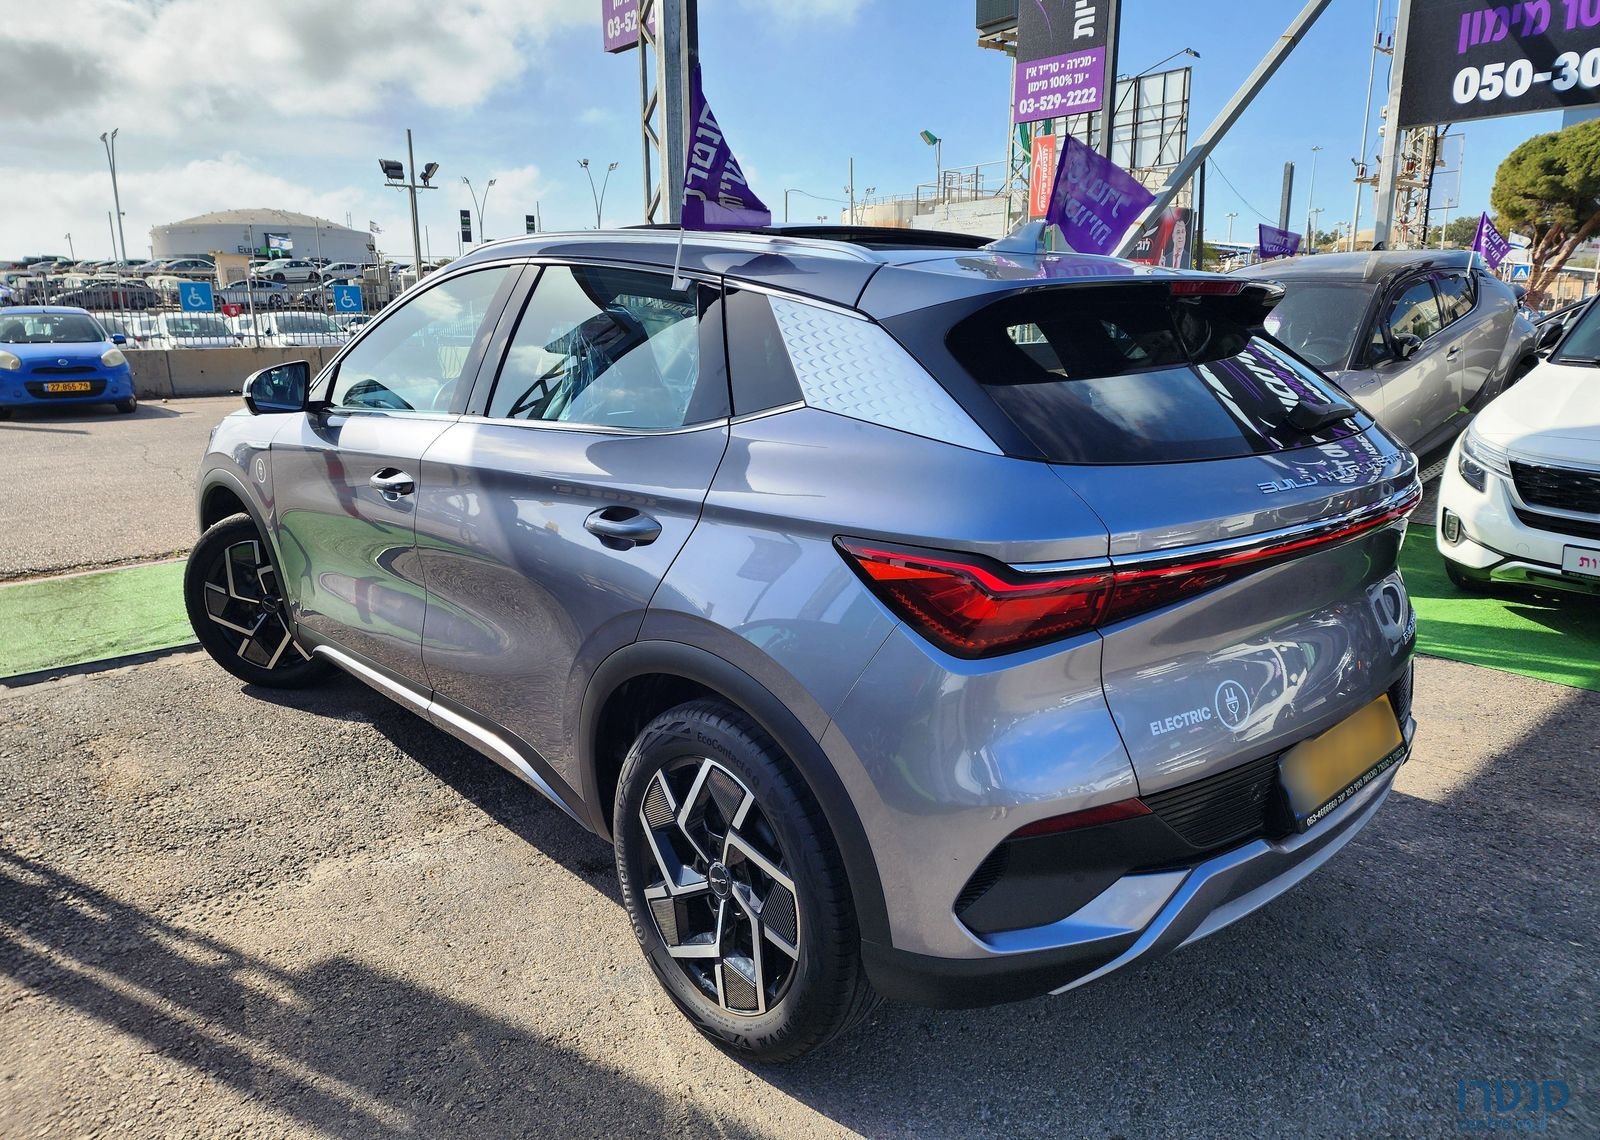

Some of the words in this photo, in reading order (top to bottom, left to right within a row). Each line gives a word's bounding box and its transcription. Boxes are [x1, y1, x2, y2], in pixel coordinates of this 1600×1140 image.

[1457, 0, 1551, 54] מימון
[1038, 62, 1059, 75] טרייד
[1066, 55, 1092, 70] מכירה
[1025, 67, 1038, 80] אין
[1050, 73, 1073, 88] 100%
[1073, 73, 1085, 84] עד
[1453, 47, 1600, 104] 050-30
[1028, 80, 1048, 94] מימון
[1019, 87, 1097, 114] 03-529-2222
[1149, 706, 1212, 737] ELECTRIC
[697, 731, 745, 770] EcoContact
